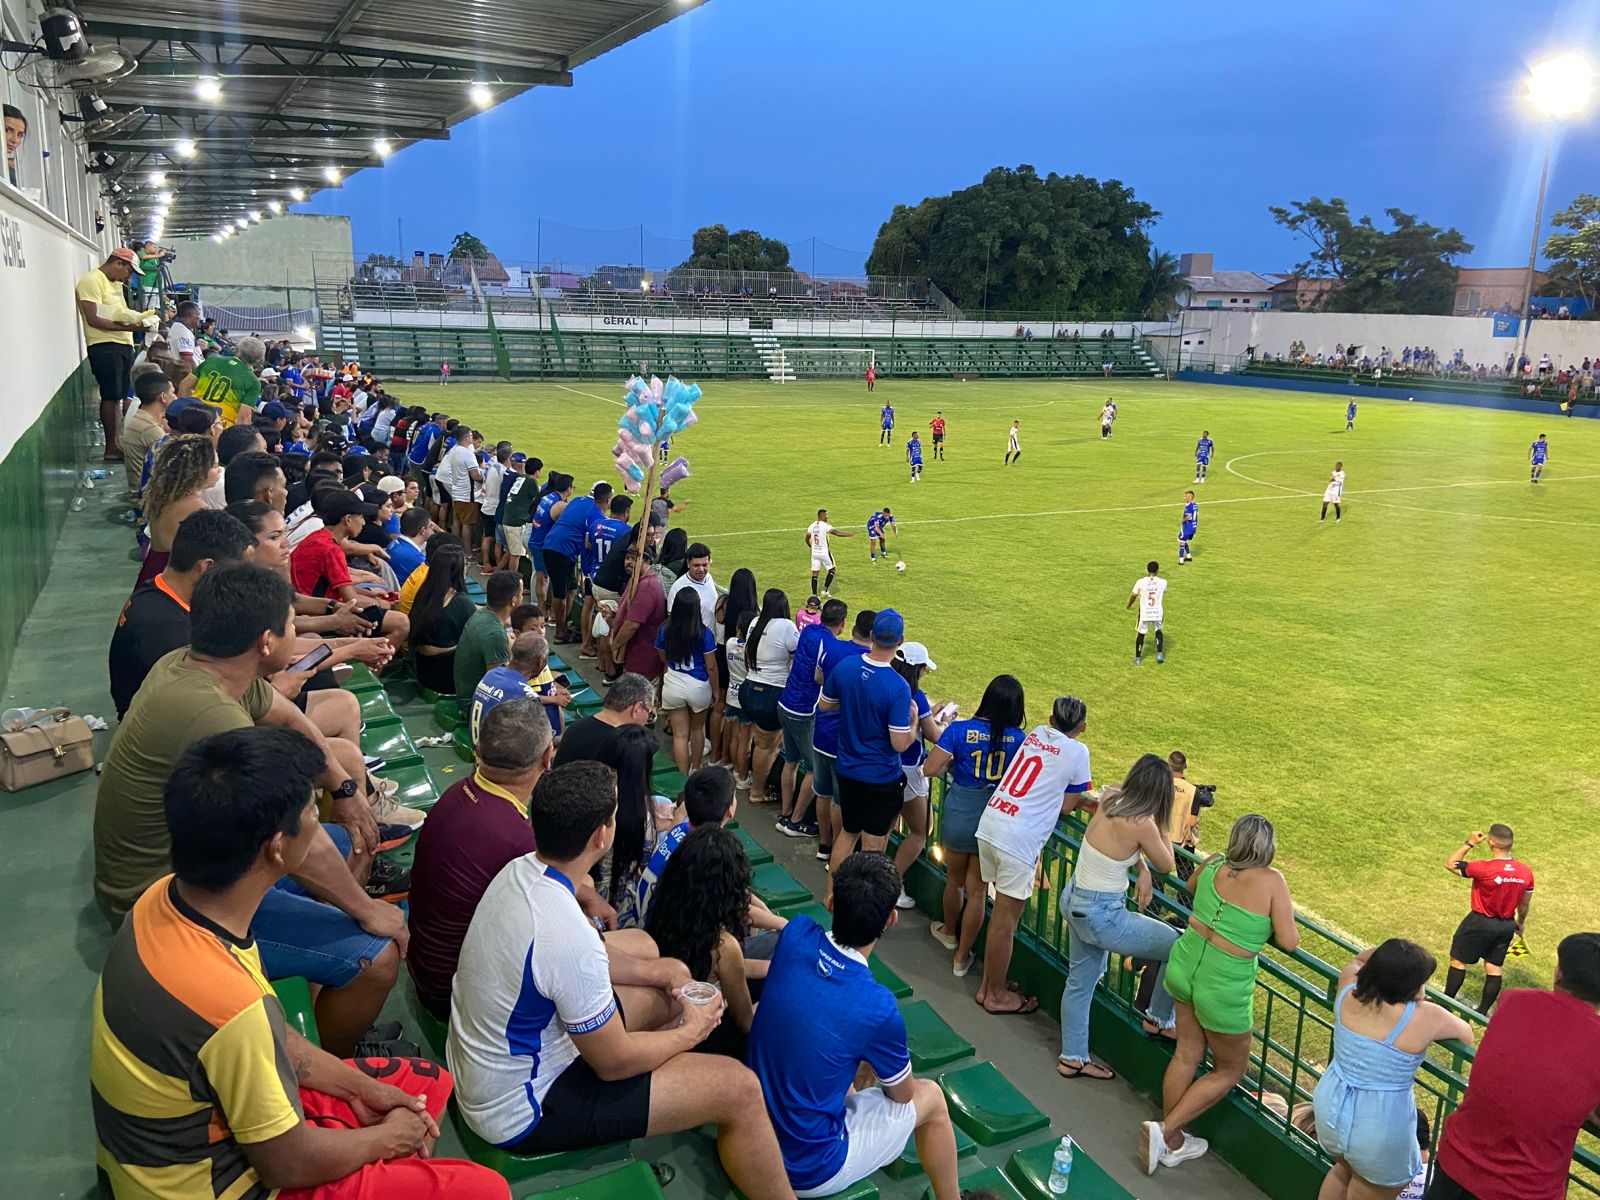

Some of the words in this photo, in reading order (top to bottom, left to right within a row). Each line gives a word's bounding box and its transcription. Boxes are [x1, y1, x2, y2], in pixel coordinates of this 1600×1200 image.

[603, 316, 639, 326] GERAL
[643, 317, 648, 326] 1
[203, 370, 232, 402] 10
[813, 533, 820, 546] 6
[1148, 591, 1156, 607] 5
[970, 749, 1006, 781] 10
[1000, 748, 1043, 798] 10
